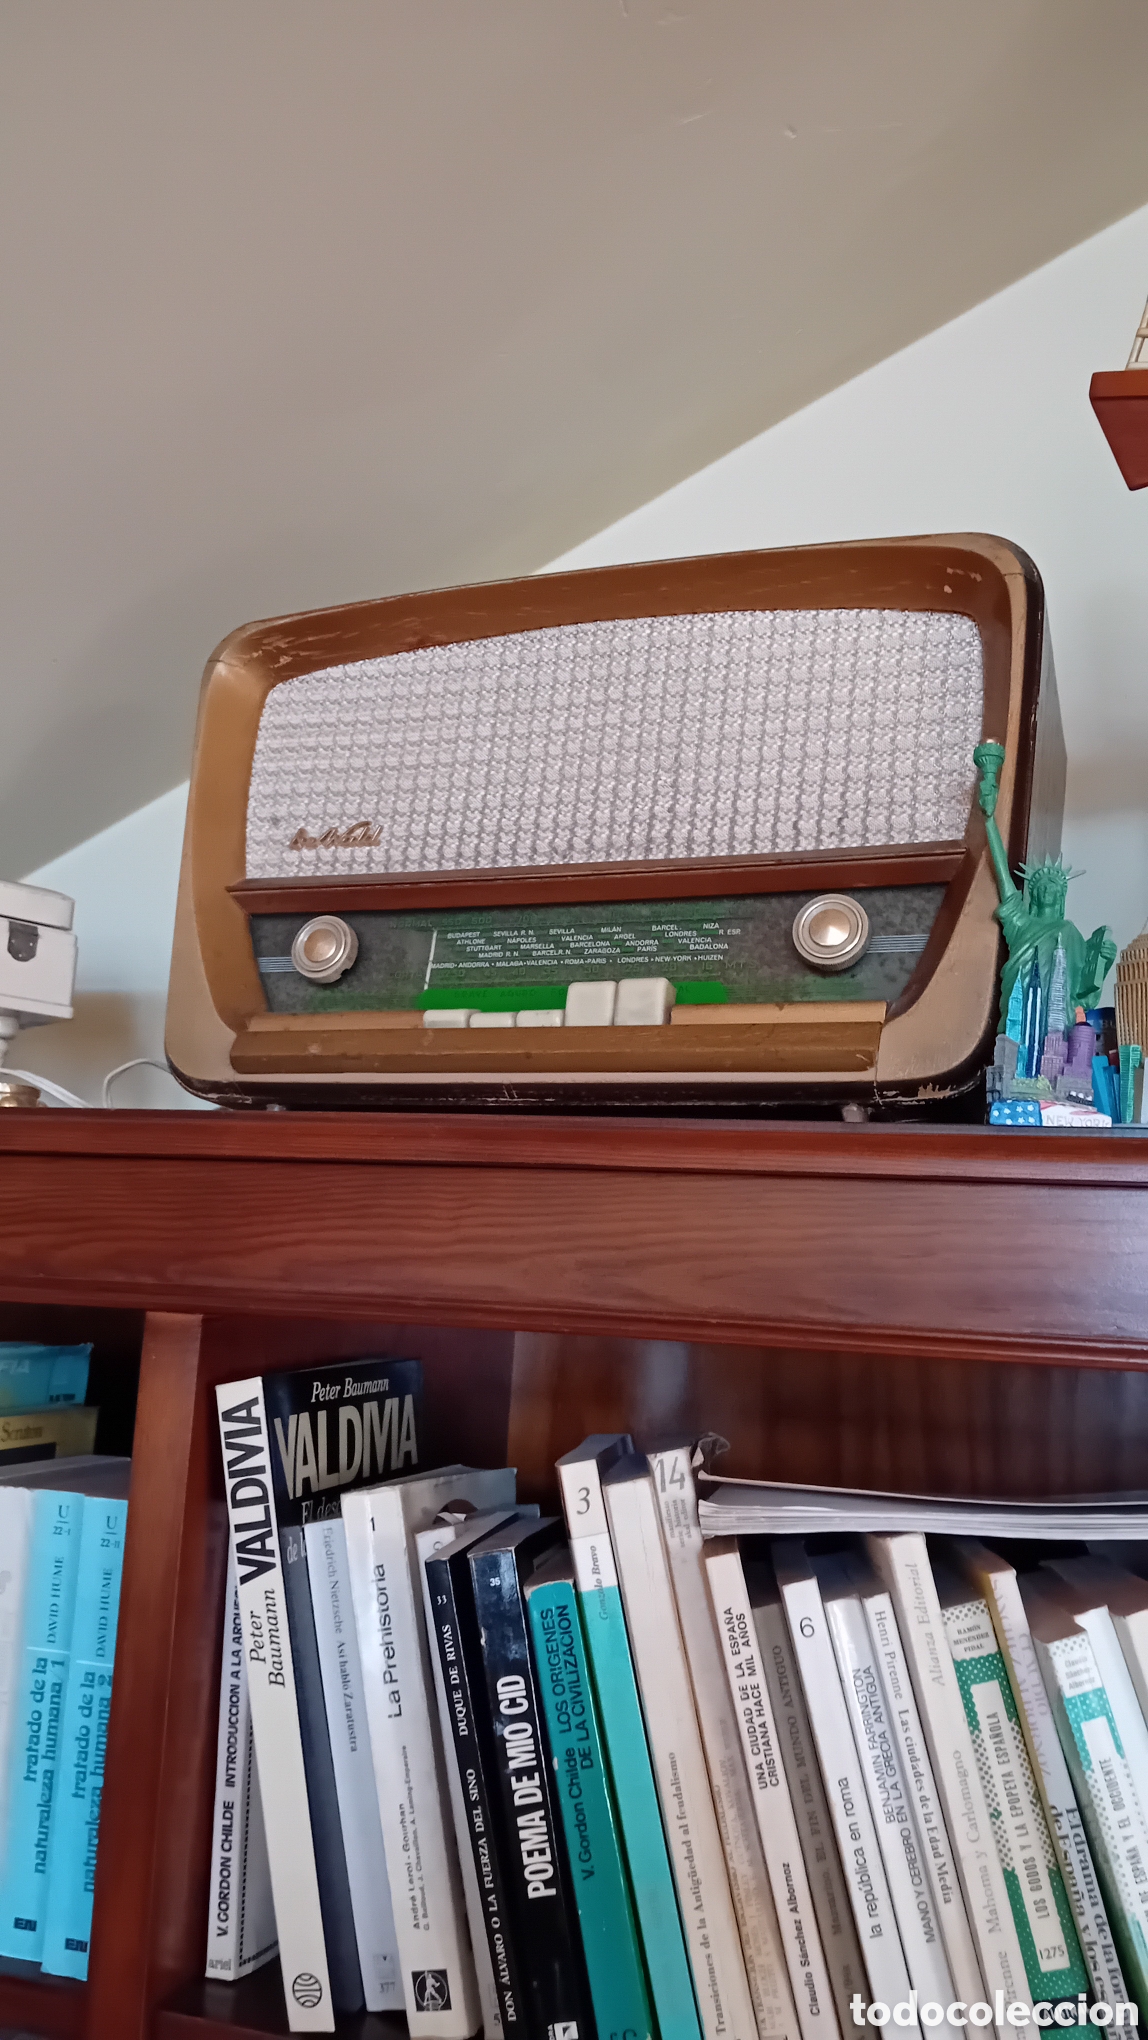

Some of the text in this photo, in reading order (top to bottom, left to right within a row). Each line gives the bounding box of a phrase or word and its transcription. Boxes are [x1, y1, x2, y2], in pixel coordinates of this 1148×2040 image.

[447, 931, 480, 939] BUDAPEST
[549, 927, 575, 935] SEVILLA
[702, 922, 720, 930] NIZA
[466, 944, 502, 952] STUTTGART
[569, 940, 611, 949] BARCELONA
[625, 939, 659, 947] ANDORRA
[478, 951, 504, 959] MADRID
[584, 947, 621, 955] ZARAGOZA
[561, 934, 594, 942] VALENCIA
[664, 930, 697, 938] LONDRES
[617, 956, 649, 964] LONDRES
[1045, 1115, 1074, 1126] NEW
[311, 1377, 389, 1403] Peter Baumann
[221, 1396, 275, 1585] VALDIVIA
[273, 1394, 419, 1500] VALDIVIA
[654, 1456, 686, 1494] 14
[576, 1486, 591, 1515] 3
[663, 1500, 676, 1539] manifiesto
[670, 1498, 681, 1527] historia
[678, 1498, 689, 1520] editor
[46, 1557, 63, 1643] DAVID HUME
[95, 1569, 112, 1657] DAVID HUME
[489, 1576, 501, 1586] 35
[589, 1545, 610, 1621] Gonzalo Bravo
[799, 1616, 815, 1638] 6
[904, 1562, 945, 1687] Alianza Editorial
[249, 1609, 266, 1664] Peter
[260, 1588, 285, 1688] Baumann
[323, 1527, 357, 1752] Friedrich Nietzsche Zaratustra
[375, 1563, 402, 1718] La Prehistoria
[441, 1624, 468, 1735] DUQUE DE RIVAS
[556, 1604, 594, 1769] DE LA CIVILIZACION
[963, 1643, 984, 1653] PIDAL
[23, 1657, 48, 1782] tratado de la
[71, 1671, 96, 1799] tratado de la
[90, 1696, 112, 1776] humana
[554, 1699, 572, 1733] LOS
[723, 1606, 768, 1789] UNA CIUDAD DE LA ESPAÑA
[735, 1612, 779, 1787] CRISTIANA HACE MIL AÑOS
[772, 1644, 821, 1835] FIN DEL MUNDO ANTIGUO
[852, 1667, 896, 1823] BENJAMIN FARRINGTON
[34, 1681, 63, 1874] naturaleza humana
[217, 1648, 242, 1922] GORDON CHILDE INTRODUCCION LA
[496, 1673, 556, 1898] POEMA DE MIO CID
[564, 1747, 582, 1799] Childe
[862, 1665, 936, 1943] MANO CEREBRO EN LA GRECIA ANTIGUA
[874, 1610, 952, 1904] Henri Pirenne Las ciudades de Edad Media
[573, 1802, 592, 1863] Gordon
[837, 1776, 883, 1938] la república en roma
[952, 1749, 1002, 1934] Mahoma Carlomagno
[986, 1711, 1050, 1919] LOS GODOS LA EPOPEYA ESPAÑOLA
[1098, 1757, 1148, 1885] ESPAÑA OCCIDENTE
[409, 1894, 420, 1929] André
[466, 1768, 516, 2021] DON ÁLVARO LA FUERZA DEL SINO
[668, 1752, 726, 2035] Transiciones de Antigüedad feudalismo
[1056, 1832, 1103, 1972] España los
[1071, 1830, 1111, 1941] drama de
[782, 1862, 820, 2016] Claudio Sánchez Albornoz
[1039, 1945, 1065, 1960] 1275
